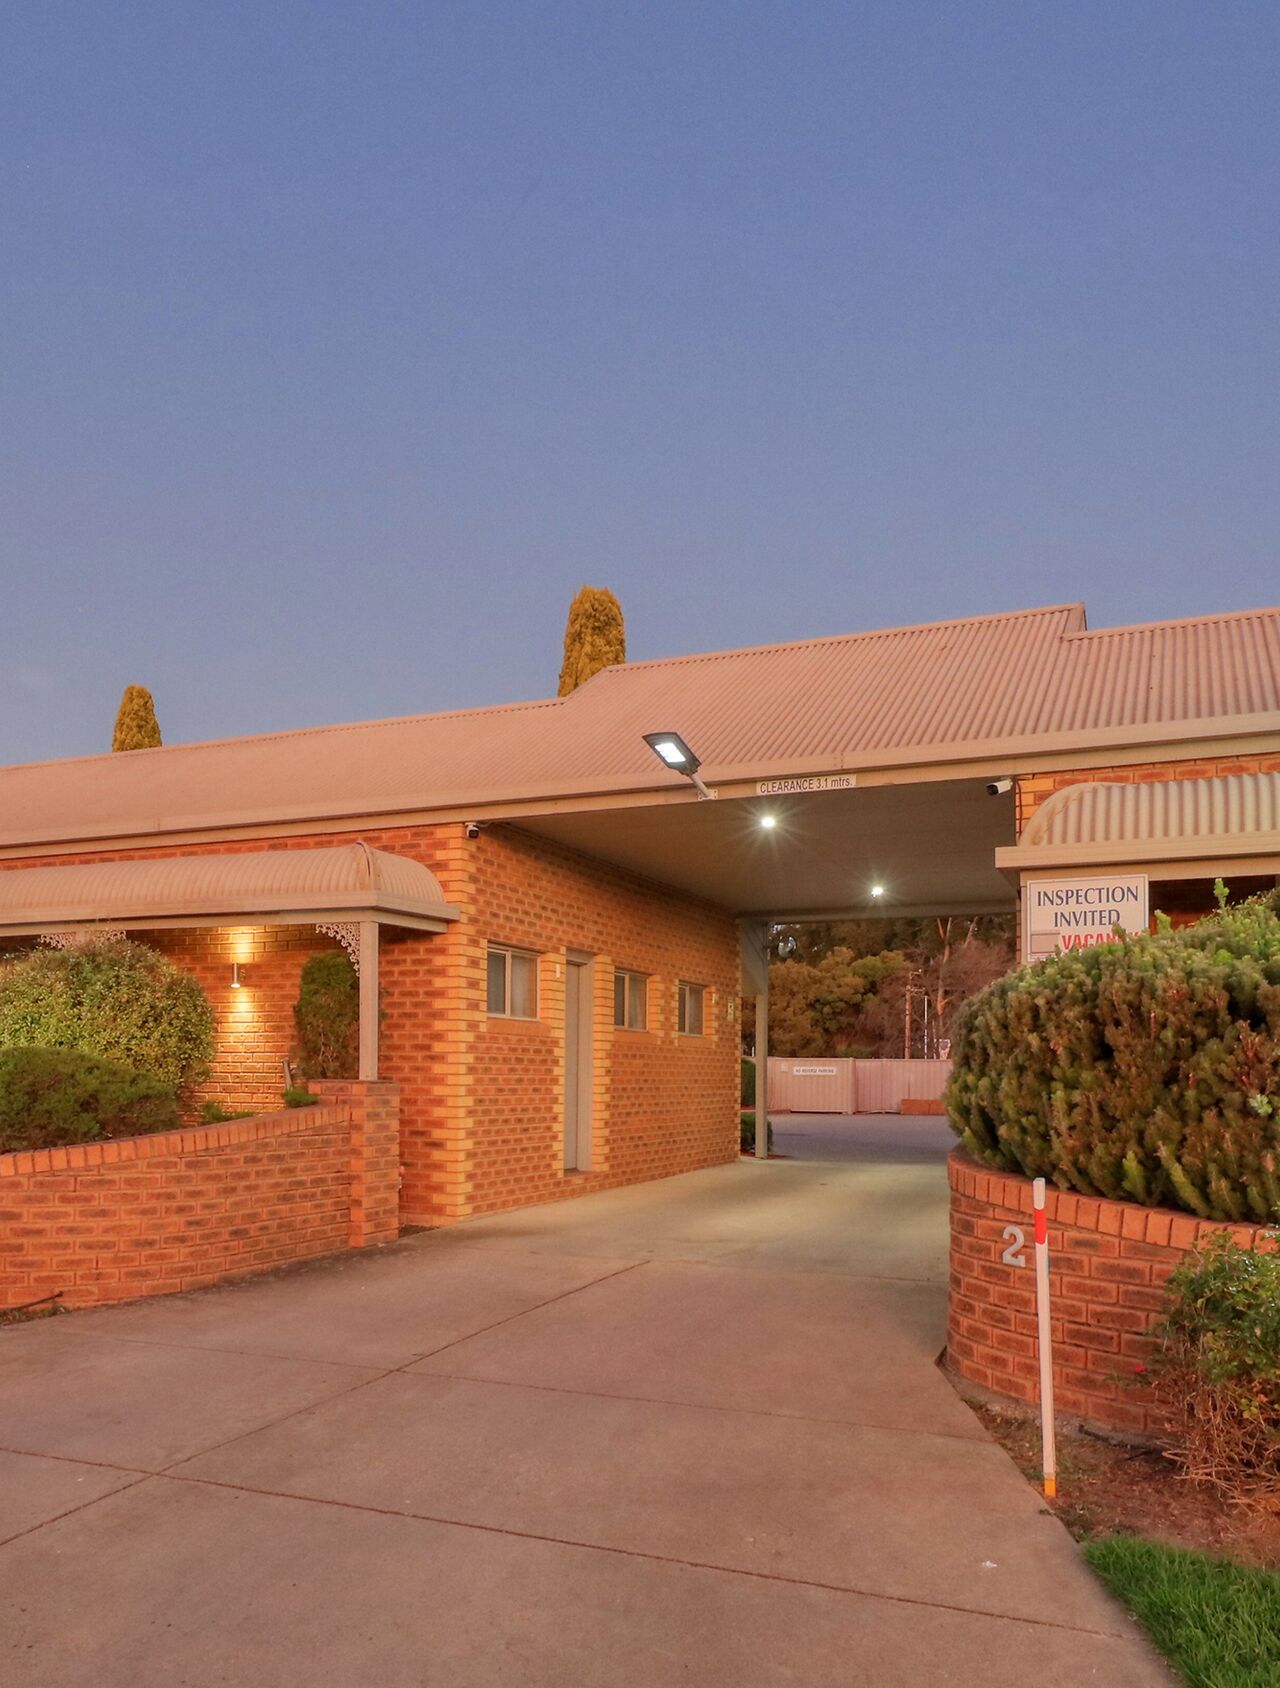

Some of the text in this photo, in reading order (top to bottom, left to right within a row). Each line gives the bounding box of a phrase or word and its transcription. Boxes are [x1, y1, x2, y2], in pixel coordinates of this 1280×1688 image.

[760, 777, 853, 794] CLEARANCE 3.1 mtrs.
[1037, 886, 1139, 906] INSPECTION
[1054, 909, 1120, 928] INVITED
[1062, 931, 1140, 951] VACAN
[1002, 1225, 1026, 1268] 2
